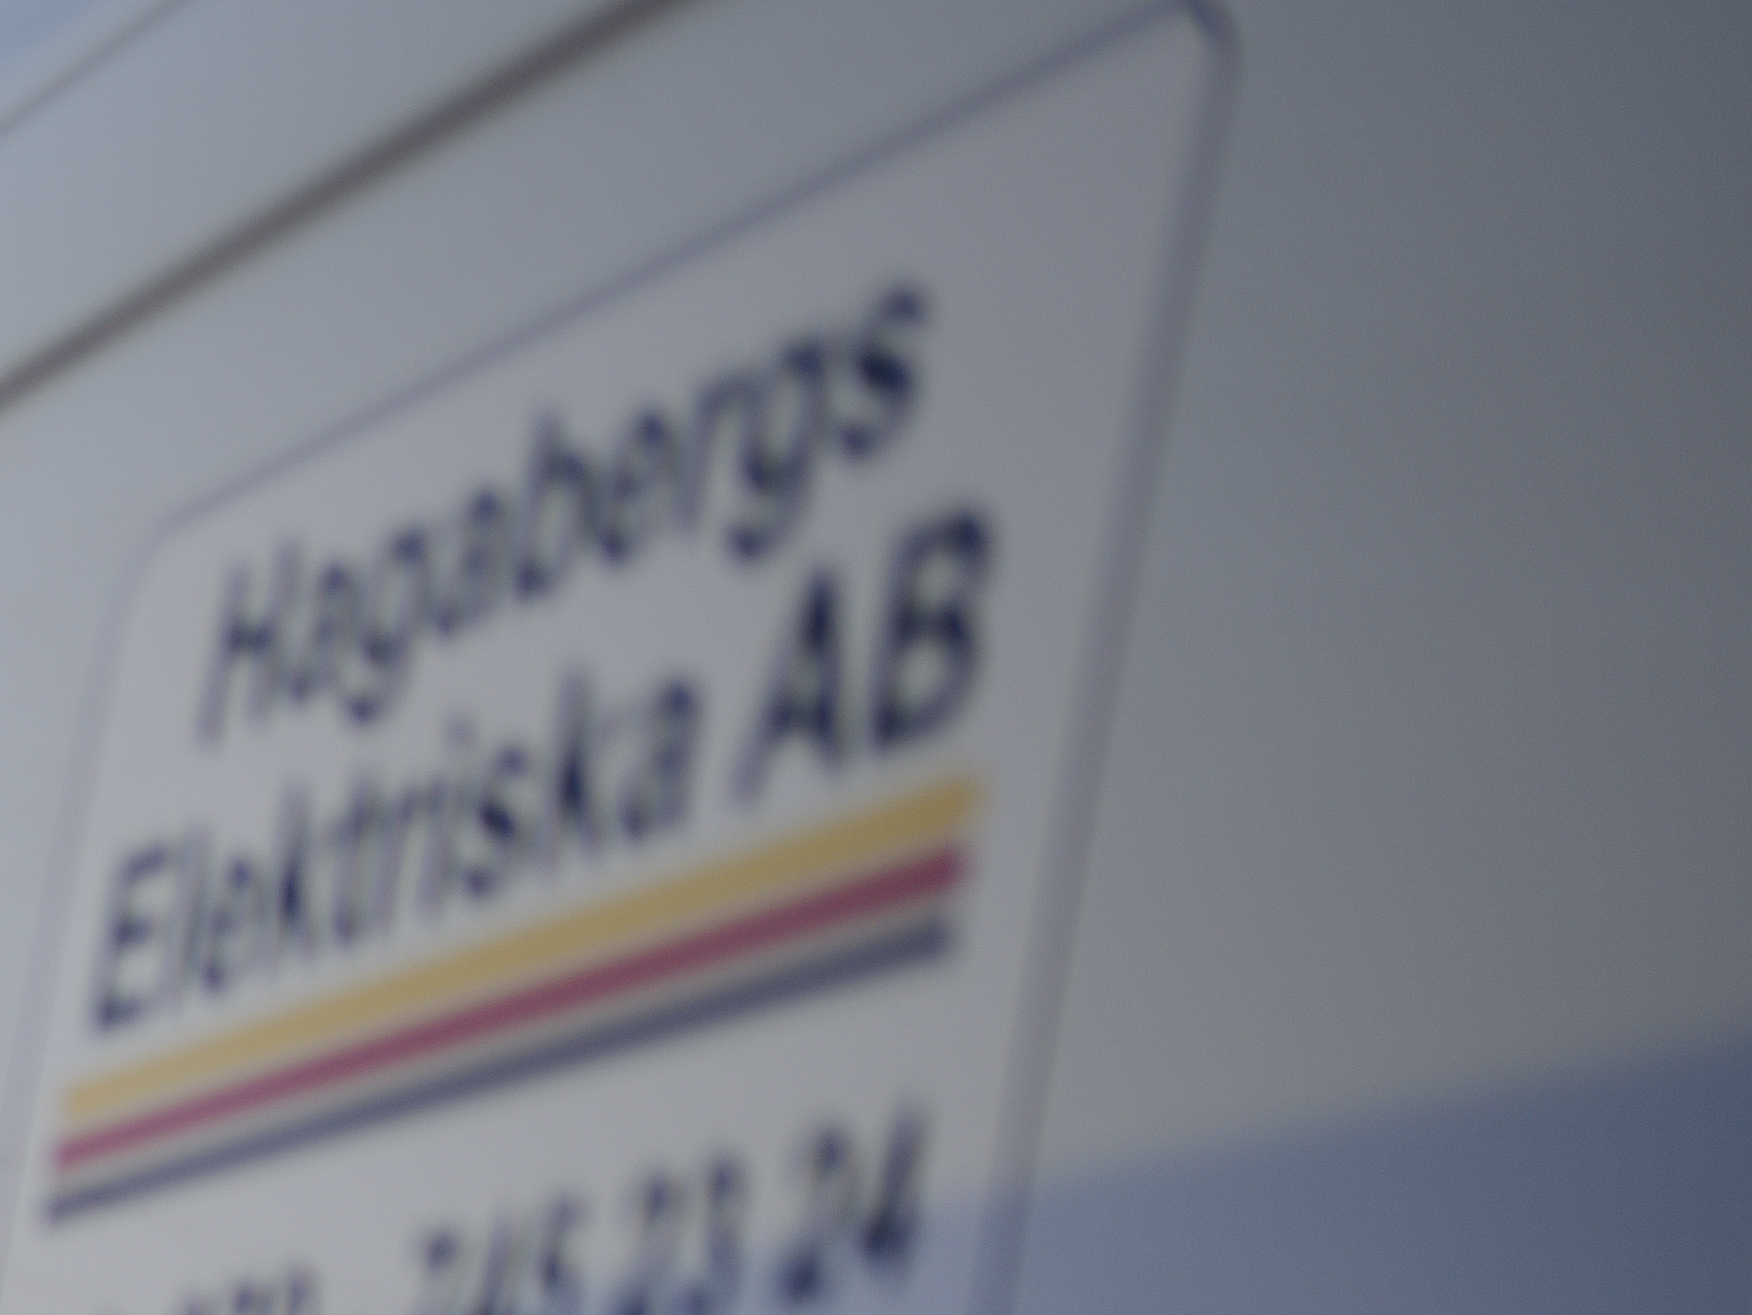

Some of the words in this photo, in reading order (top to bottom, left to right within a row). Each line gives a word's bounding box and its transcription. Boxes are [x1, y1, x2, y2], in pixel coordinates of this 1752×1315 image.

[200, 283, 930, 746] Hagabergs
[89, 664, 700, 1033] Elektriska
[733, 504, 996, 804] AB
[774, 1098, 928, 1311] 24
